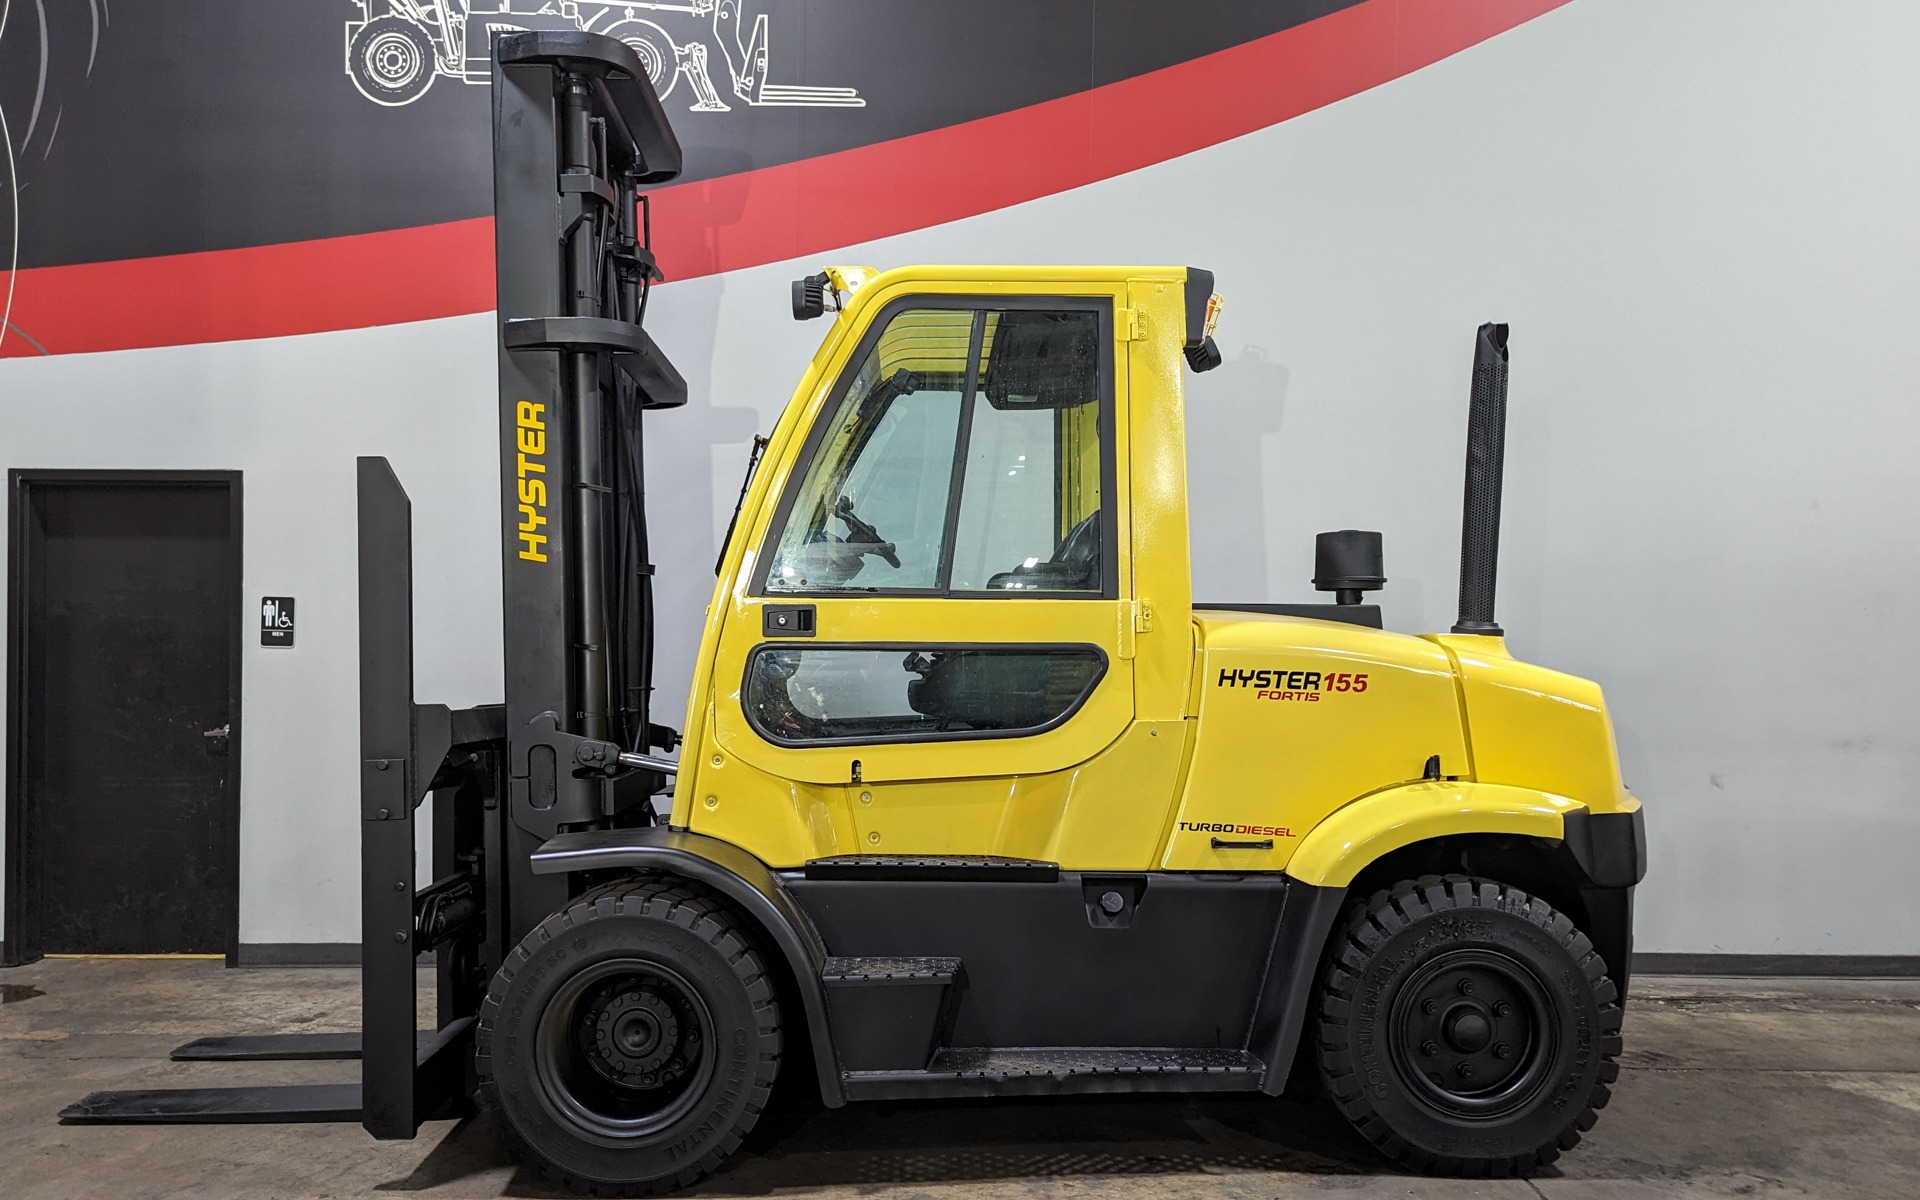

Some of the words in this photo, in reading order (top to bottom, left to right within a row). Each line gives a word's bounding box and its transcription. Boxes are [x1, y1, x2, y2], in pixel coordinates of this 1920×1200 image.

[517, 400, 548, 563] HYSTER
[1218, 668, 1322, 691] HYSTER
[1323, 672, 1369, 693] 155
[1256, 690, 1321, 702] FORTIS
[1179, 822, 1235, 833] TURBO
[1235, 824, 1297, 837] DIESEL
[663, 1028, 747, 1158] CONTINENTAL
